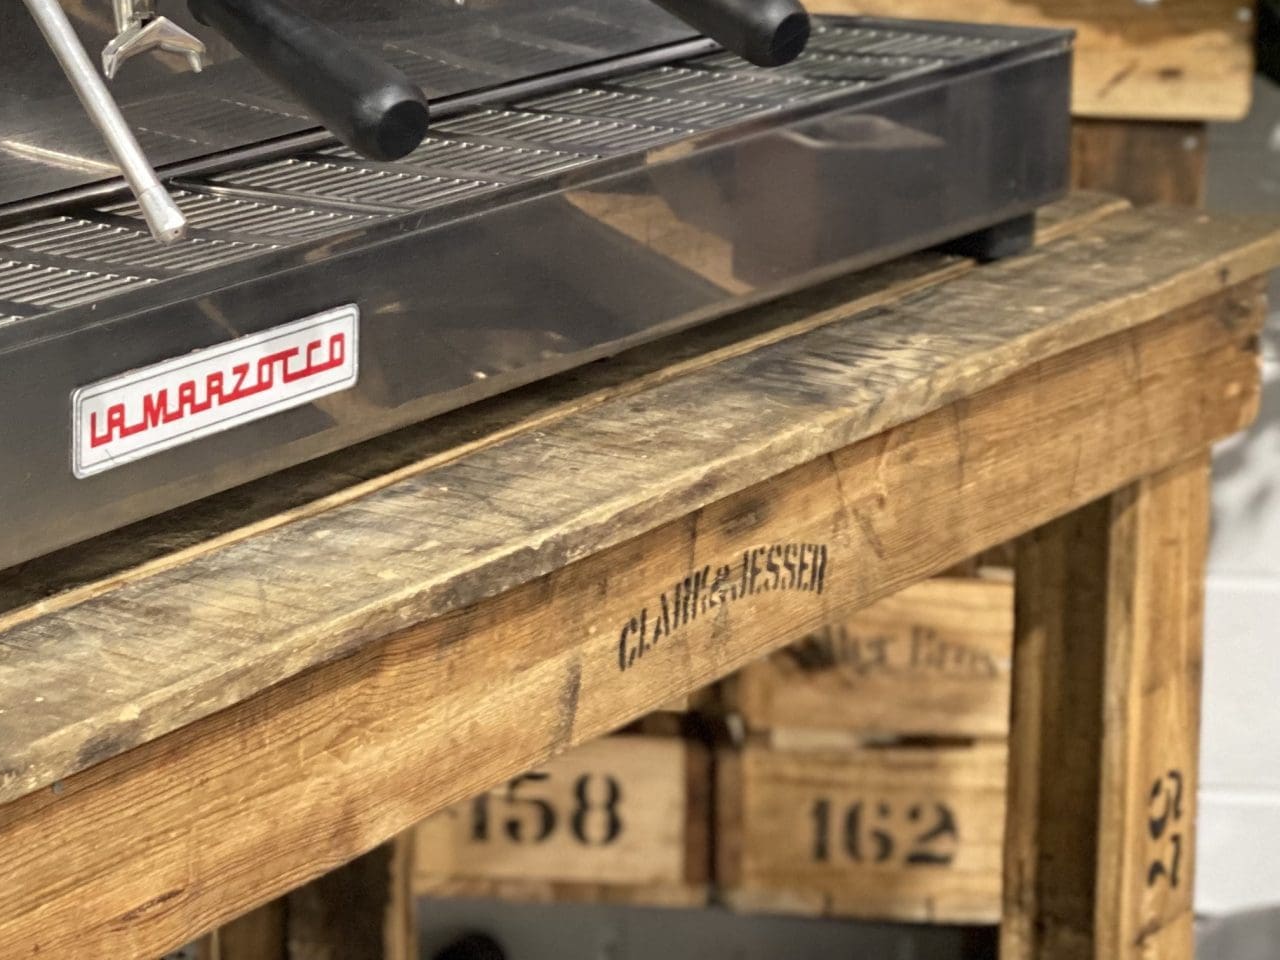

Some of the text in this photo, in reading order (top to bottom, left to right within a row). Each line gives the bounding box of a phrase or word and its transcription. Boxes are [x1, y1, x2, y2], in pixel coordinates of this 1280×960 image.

[90, 402, 126, 449] LA
[470, 771, 622, 846] 158
[811, 798, 960, 866] 162
